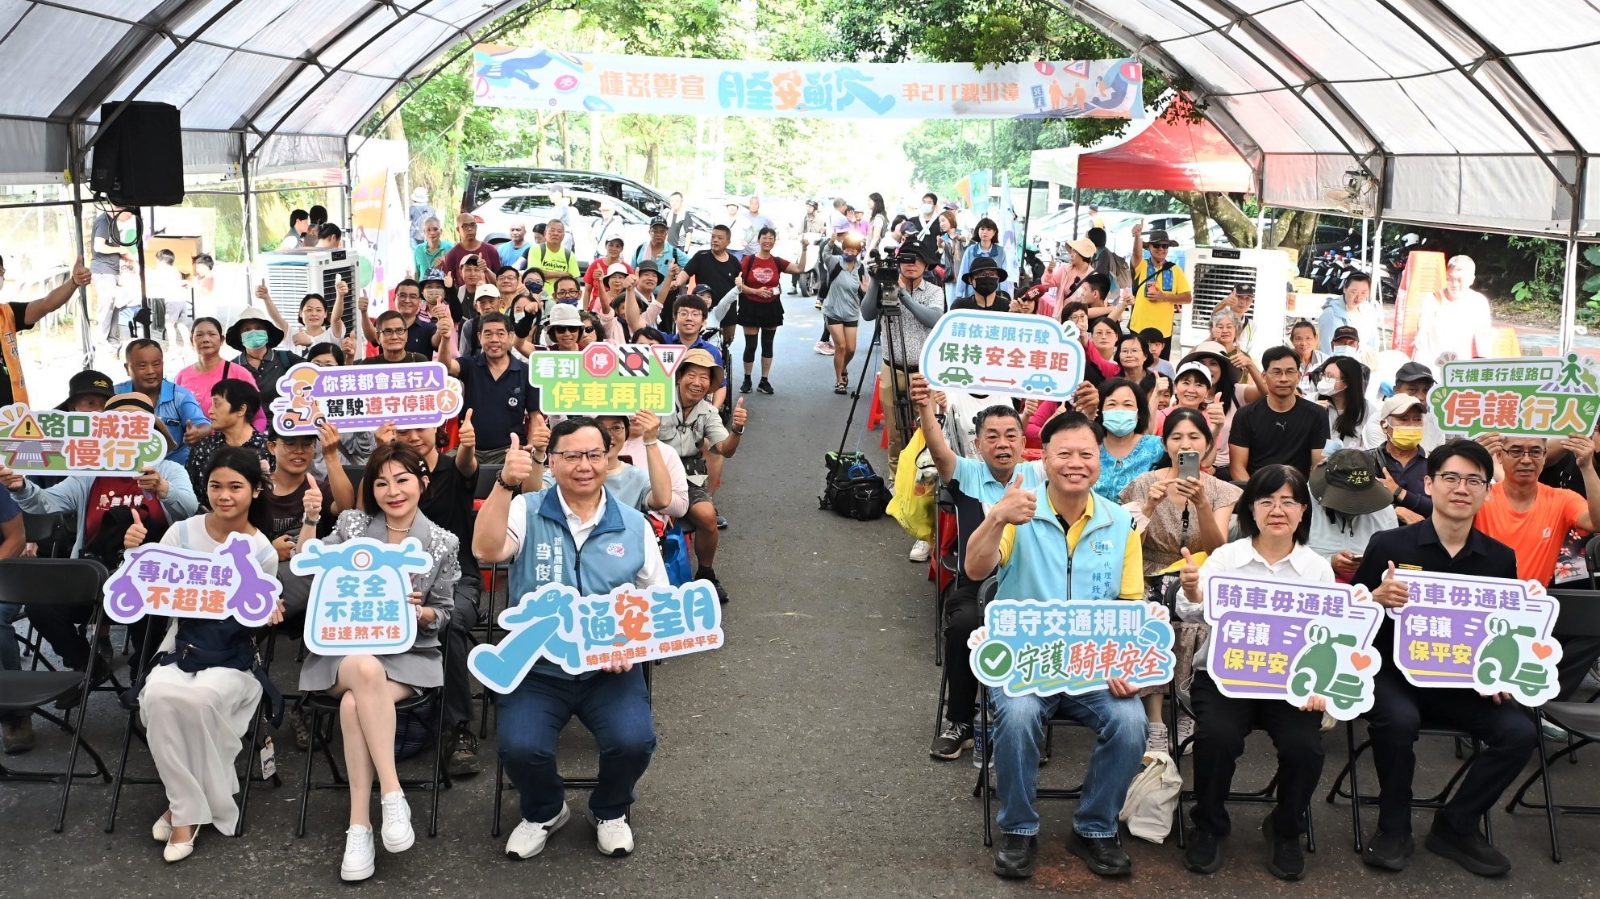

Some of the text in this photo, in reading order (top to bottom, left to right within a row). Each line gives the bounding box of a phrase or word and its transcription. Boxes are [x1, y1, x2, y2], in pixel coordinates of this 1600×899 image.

[951, 322, 1049, 344] 請依速限行駛
[535, 357, 579, 379] 看到
[591, 353, 609, 369] 停
[938, 342, 1069, 372] 保持安全車距
[322, 370, 440, 392] 你我都會是行人
[1450, 367, 1554, 383] 汽機車行經路口
[326, 394, 435, 417] 駕駛遵守停讓
[552, 380, 666, 409] 停車再開
[1444, 391, 1586, 430] 停讓行人
[38, 413, 150, 440] 路口減速
[65, 440, 137, 468] 慢行
[138, 560, 233, 587] 專心駕駛
[336, 574, 387, 598] 安全
[146, 586, 226, 613] 不超速
[324, 600, 400, 622] 不超速
[1216, 584, 1344, 618] 騎車毋通趕
[321, 624, 401, 641] 超速煞不住
[993, 608, 1142, 637] 遵守交通規則
[1222, 620, 1271, 646] 停讓
[1405, 614, 1452, 638] 停讓
[1016, 639, 1168, 683] 守護騎車安全
[1223, 647, 1289, 675] 保平安
[1409, 640, 1472, 665] 保平安
